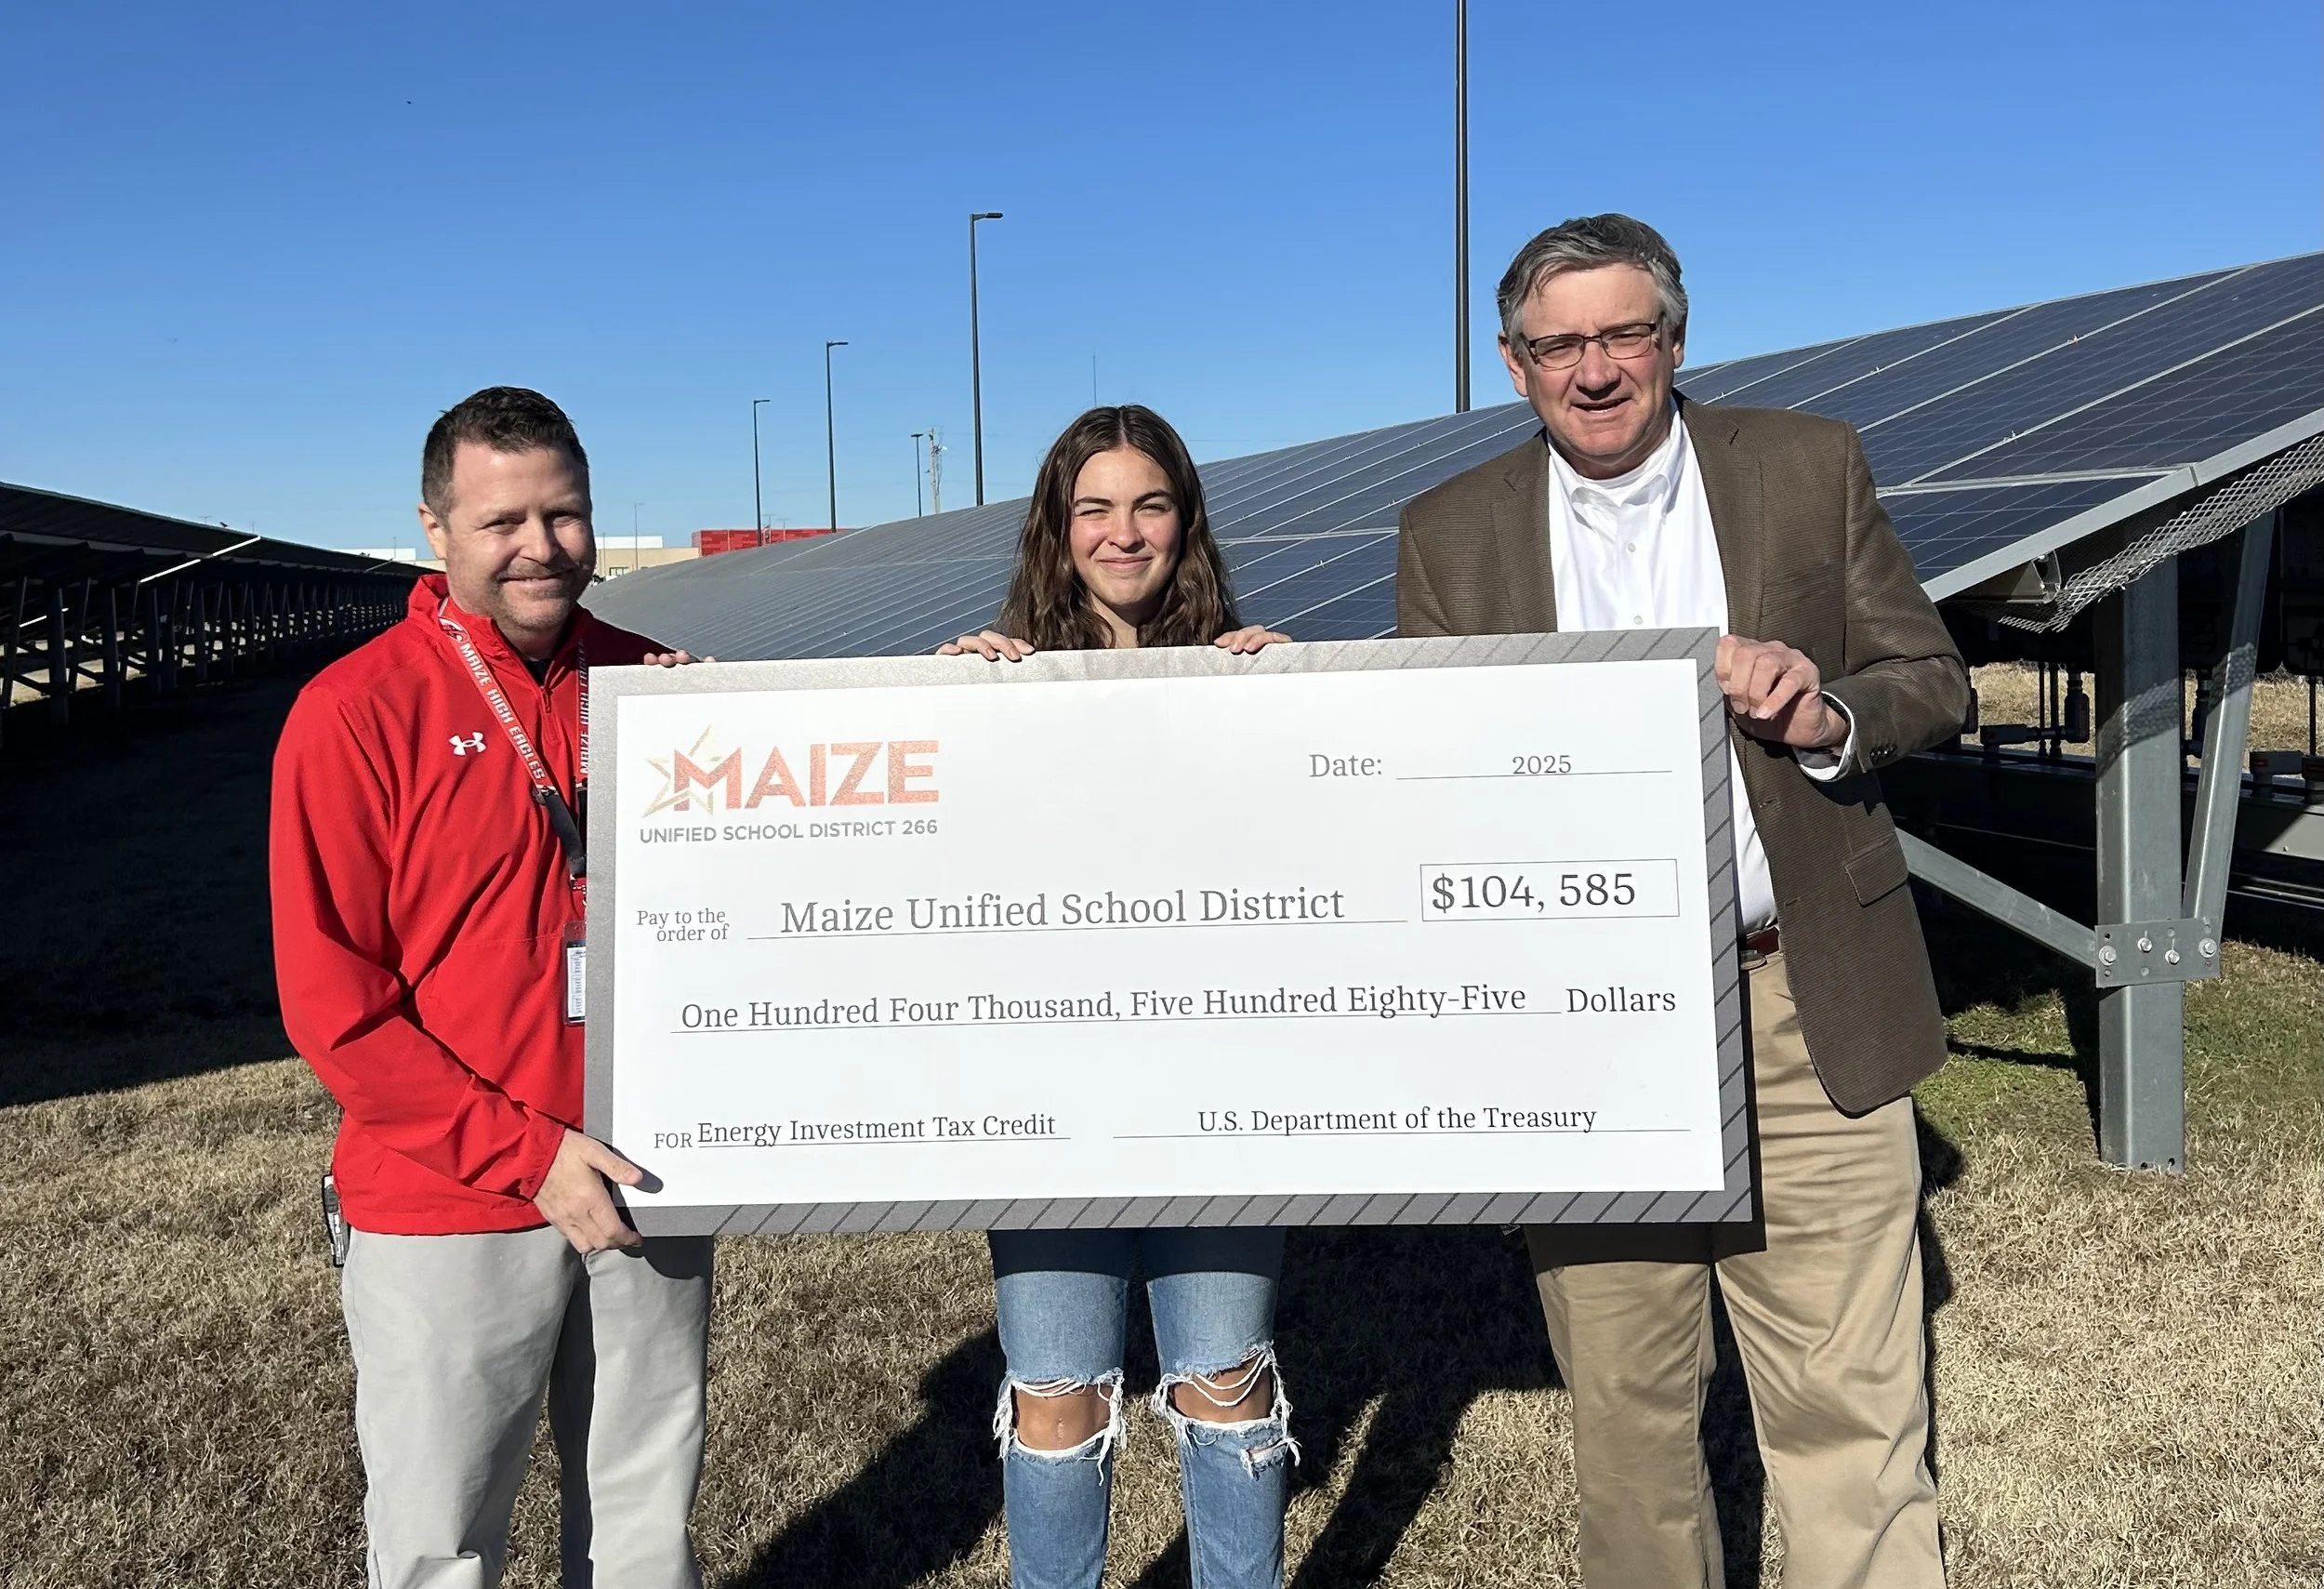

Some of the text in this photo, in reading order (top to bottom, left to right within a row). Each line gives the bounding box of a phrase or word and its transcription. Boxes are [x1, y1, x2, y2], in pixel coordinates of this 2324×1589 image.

[459, 642, 546, 780] MAIZE HIGH EAGLES
[675, 741, 941, 811] MAIZE
[1309, 754, 1572, 777] Date: 2025
[640, 818, 938, 843] UNIFIED SCHOOL DISTRICT 266
[781, 886, 1345, 934] Maize Unified School District
[1432, 872, 1636, 914] $104, 585
[636, 907, 726, 930] Pay to the
[656, 922, 730, 942] order of
[681, 984, 1677, 1027] One Hundred Four Thousand, Five Hundred Eighty-Five Dollars
[654, 1113, 1056, 1149] FOR Energy Investment Tax Credit
[1198, 1106, 1599, 1136] U.S. Department of the Treasury
